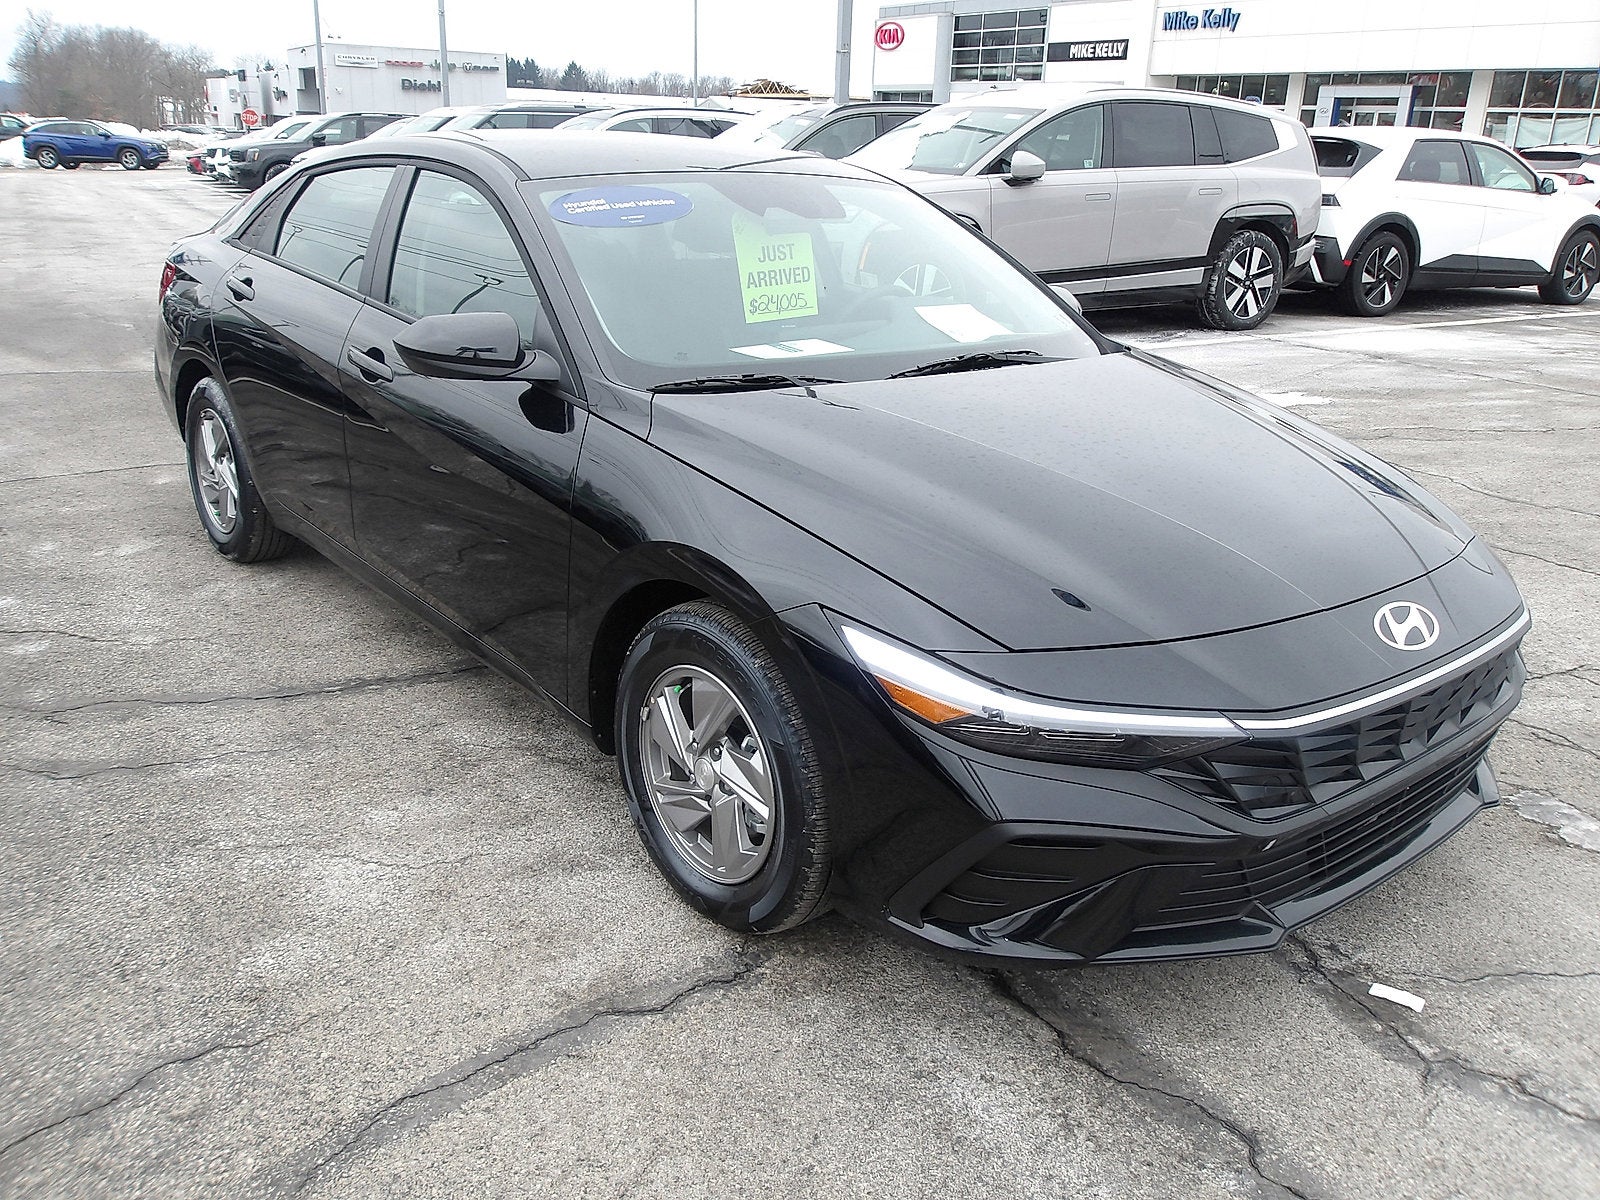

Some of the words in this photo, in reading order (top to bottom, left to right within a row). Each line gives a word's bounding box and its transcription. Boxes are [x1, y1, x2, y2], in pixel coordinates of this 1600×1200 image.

[1162, 11, 1198, 31] Mike
[1201, 8, 1241, 32] Kelly
[879, 28, 899, 44] KIA
[1070, 43, 1095, 58] MIKE
[1095, 42, 1125, 57] KELLY
[401, 78, 441, 92] Diehl
[242, 114, 258, 122] STOP
[563, 198, 606, 209] Hyundai
[567, 203, 610, 214] Certified
[611, 201, 636, 209] Used
[636, 199, 675, 207] Vehicles
[758, 243, 795, 263] JUST
[746, 266, 811, 289] ARRIVED
